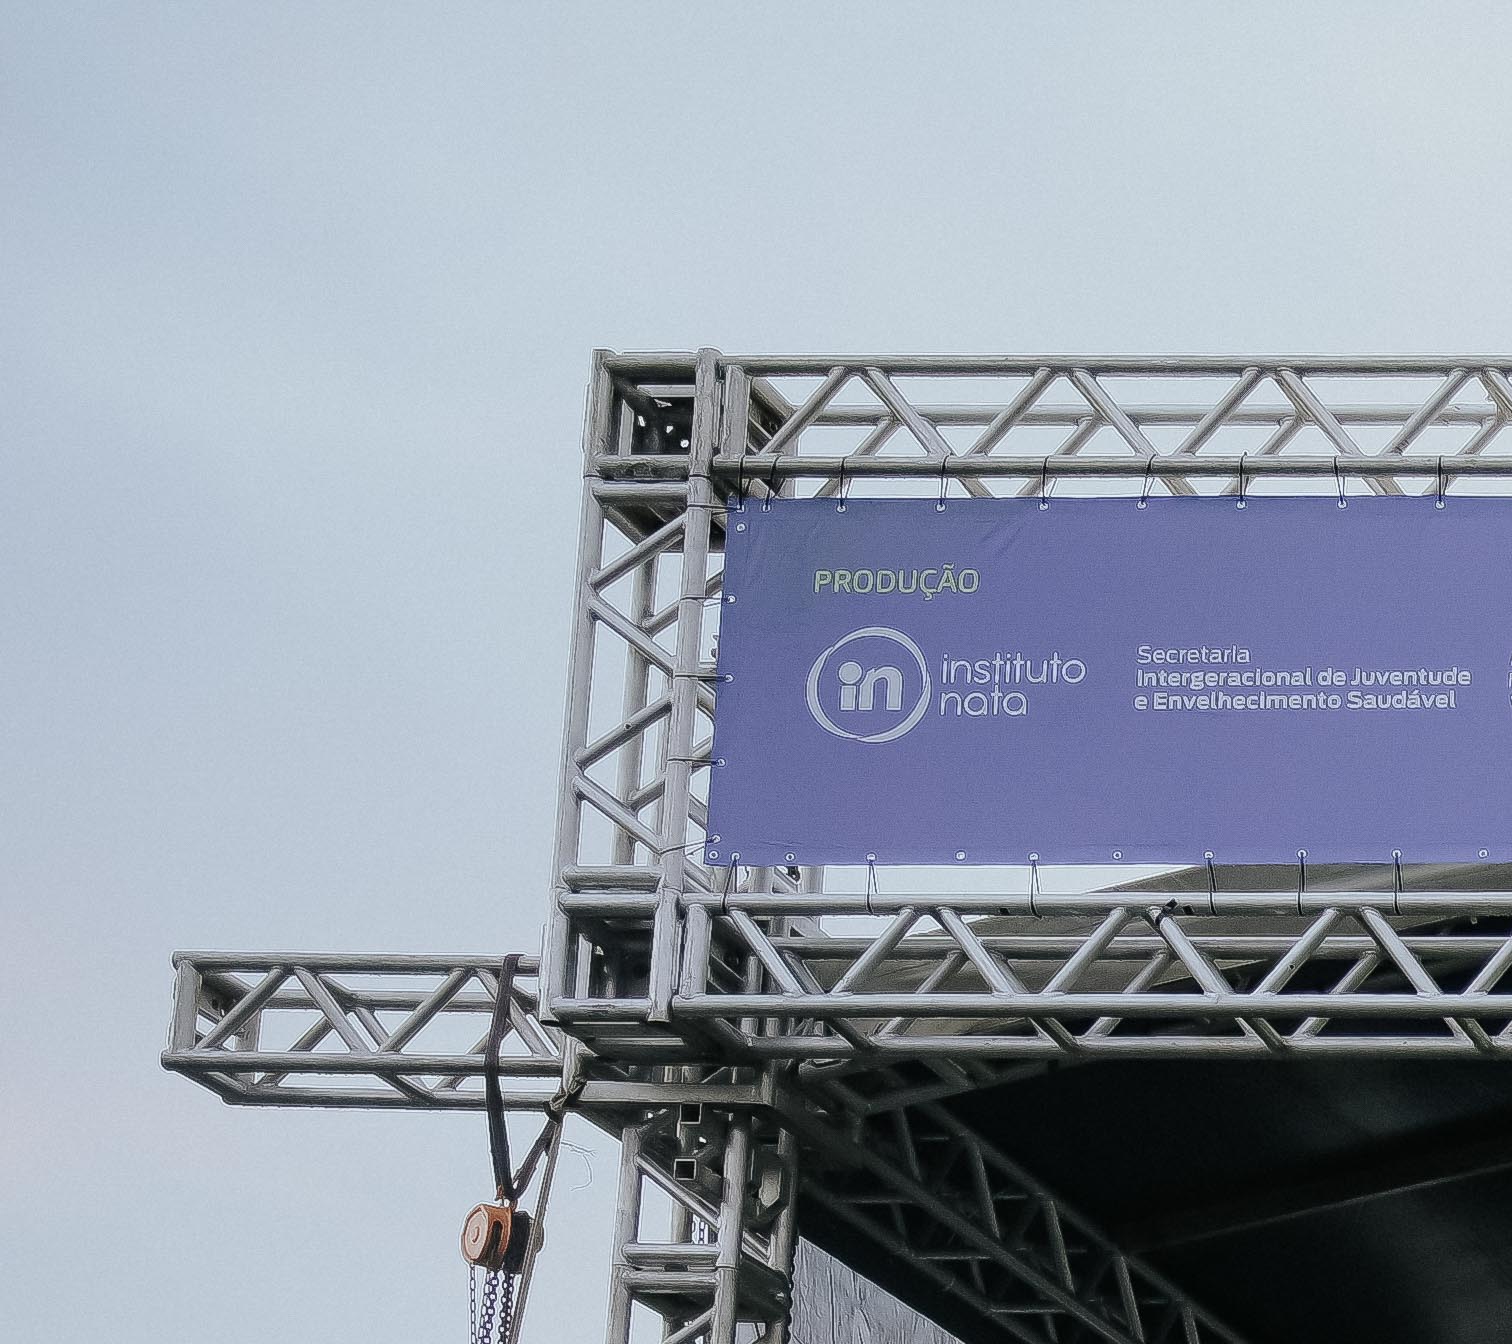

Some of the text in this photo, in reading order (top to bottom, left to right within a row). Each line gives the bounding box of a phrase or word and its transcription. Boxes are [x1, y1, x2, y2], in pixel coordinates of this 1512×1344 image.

[813, 565, 980, 600] PRODUÇÃO
[1137, 645, 1251, 665] Secretaria
[940, 652, 1087, 686] instituto
[1137, 666, 1472, 690] Intergeracional de Juventude
[940, 688, 1029, 717] nata
[1134, 690, 1457, 711] e Envelhecimento Saudável
